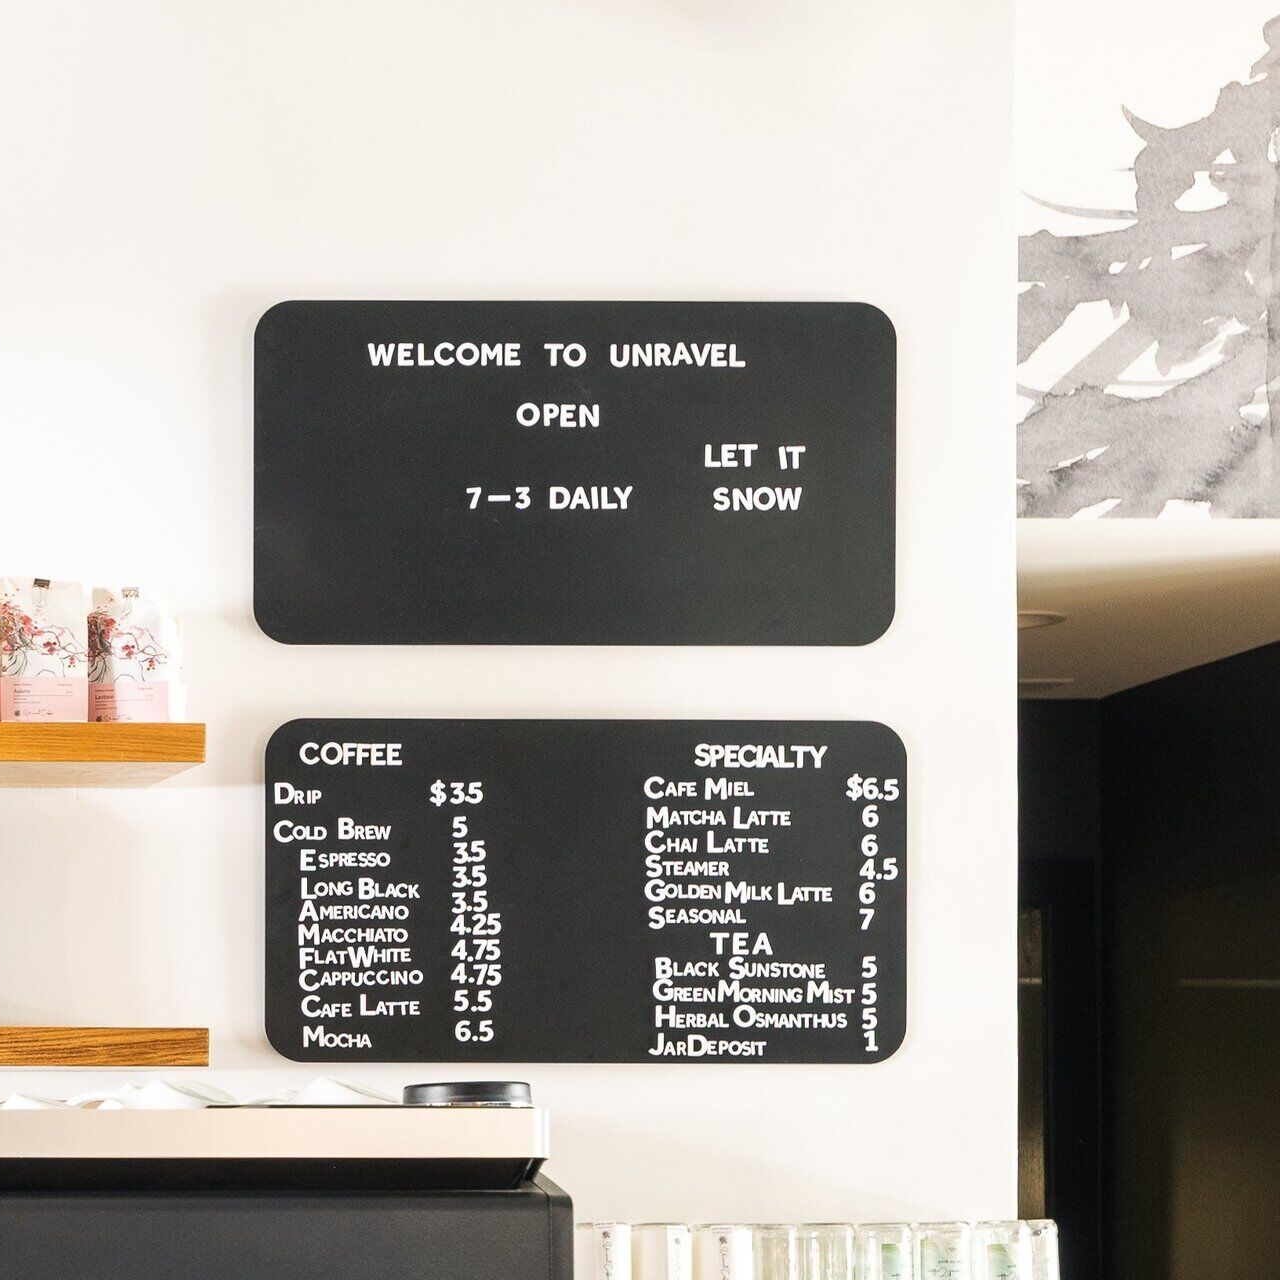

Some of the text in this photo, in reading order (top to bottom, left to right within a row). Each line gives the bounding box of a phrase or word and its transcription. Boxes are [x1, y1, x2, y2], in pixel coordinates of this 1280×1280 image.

[368, 342, 745, 368] WELCOME TO UNRAVEL
[517, 403, 599, 427] OPEN
[705, 444, 806, 469] LET IT
[550, 486, 633, 509] DAILY
[713, 487, 802, 511] SNOW
[300, 742, 402, 765] COFFEE
[695, 744, 828, 768] SPECIALTY
[846, 774, 899, 801] $6.5
[452, 816, 468, 838] 5
[862, 805, 879, 827] 6
[453, 841, 486, 864] 3.5
[861, 834, 878, 856] 6
[452, 865, 487, 888] 3.5
[860, 858, 898, 880] 4.5
[452, 891, 488, 914] 3.5
[859, 882, 875, 904] 6
[450, 913, 501, 935] 4.25
[859, 908, 874, 930] 7
[451, 939, 500, 962] 4.75
[710, 933, 773, 955] TEA
[451, 963, 501, 986] 4.75
[862, 956, 877, 978] 5
[454, 990, 492, 1012] 5.5
[861, 983, 877, 1005] 5
[862, 1008, 877, 1029] 5
[455, 1020, 494, 1041] 6.5
[864, 1031, 878, 1051] 1
